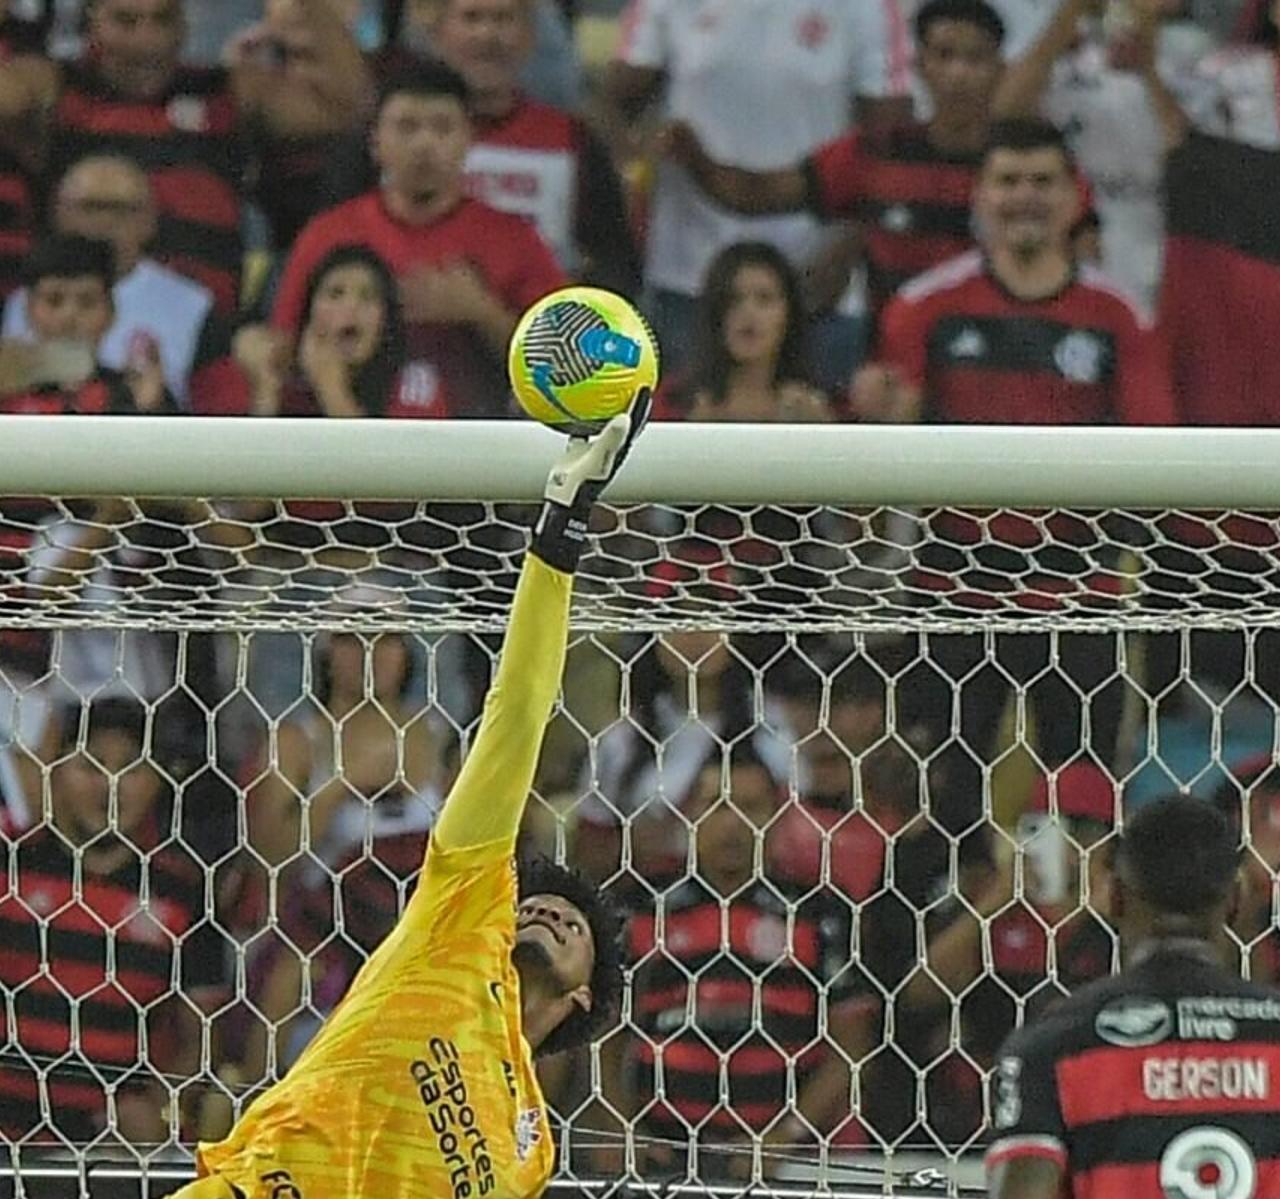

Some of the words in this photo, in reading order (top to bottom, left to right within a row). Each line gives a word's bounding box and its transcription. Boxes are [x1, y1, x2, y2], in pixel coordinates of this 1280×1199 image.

[1178, 1017, 1237, 1040] livre
[410, 1059, 441, 1106] da
[1142, 1057, 1269, 1101] GERSON
[429, 1037, 495, 1196] Esportes
